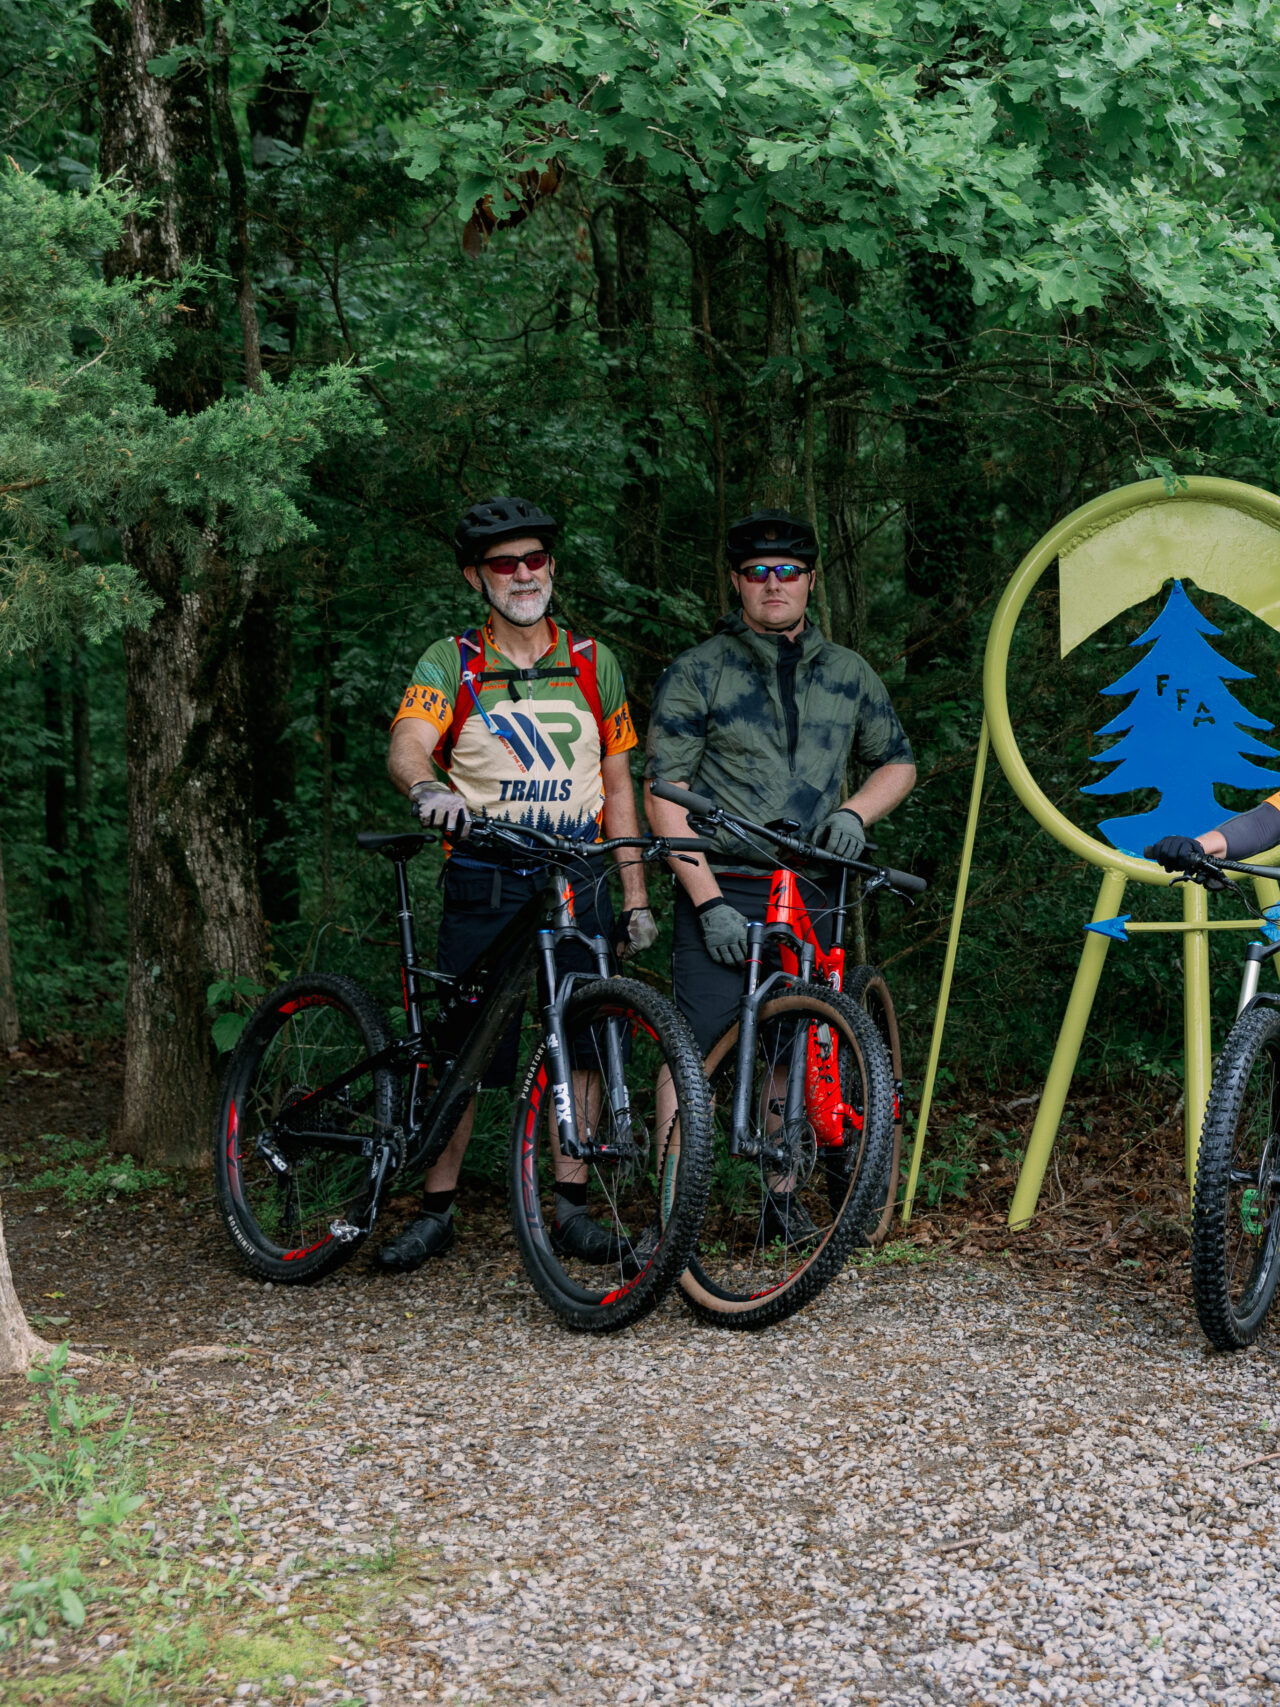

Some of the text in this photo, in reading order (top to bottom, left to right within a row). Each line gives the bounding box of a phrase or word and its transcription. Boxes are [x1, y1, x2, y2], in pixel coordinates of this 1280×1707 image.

[1156, 674, 1216, 728] FFA
[498, 778, 574, 803] TRAILS
[520, 1042, 547, 1100] PURGATORY
[552, 1081, 573, 1126] FOX
[227, 1214, 257, 1257] ELIMINATOR
